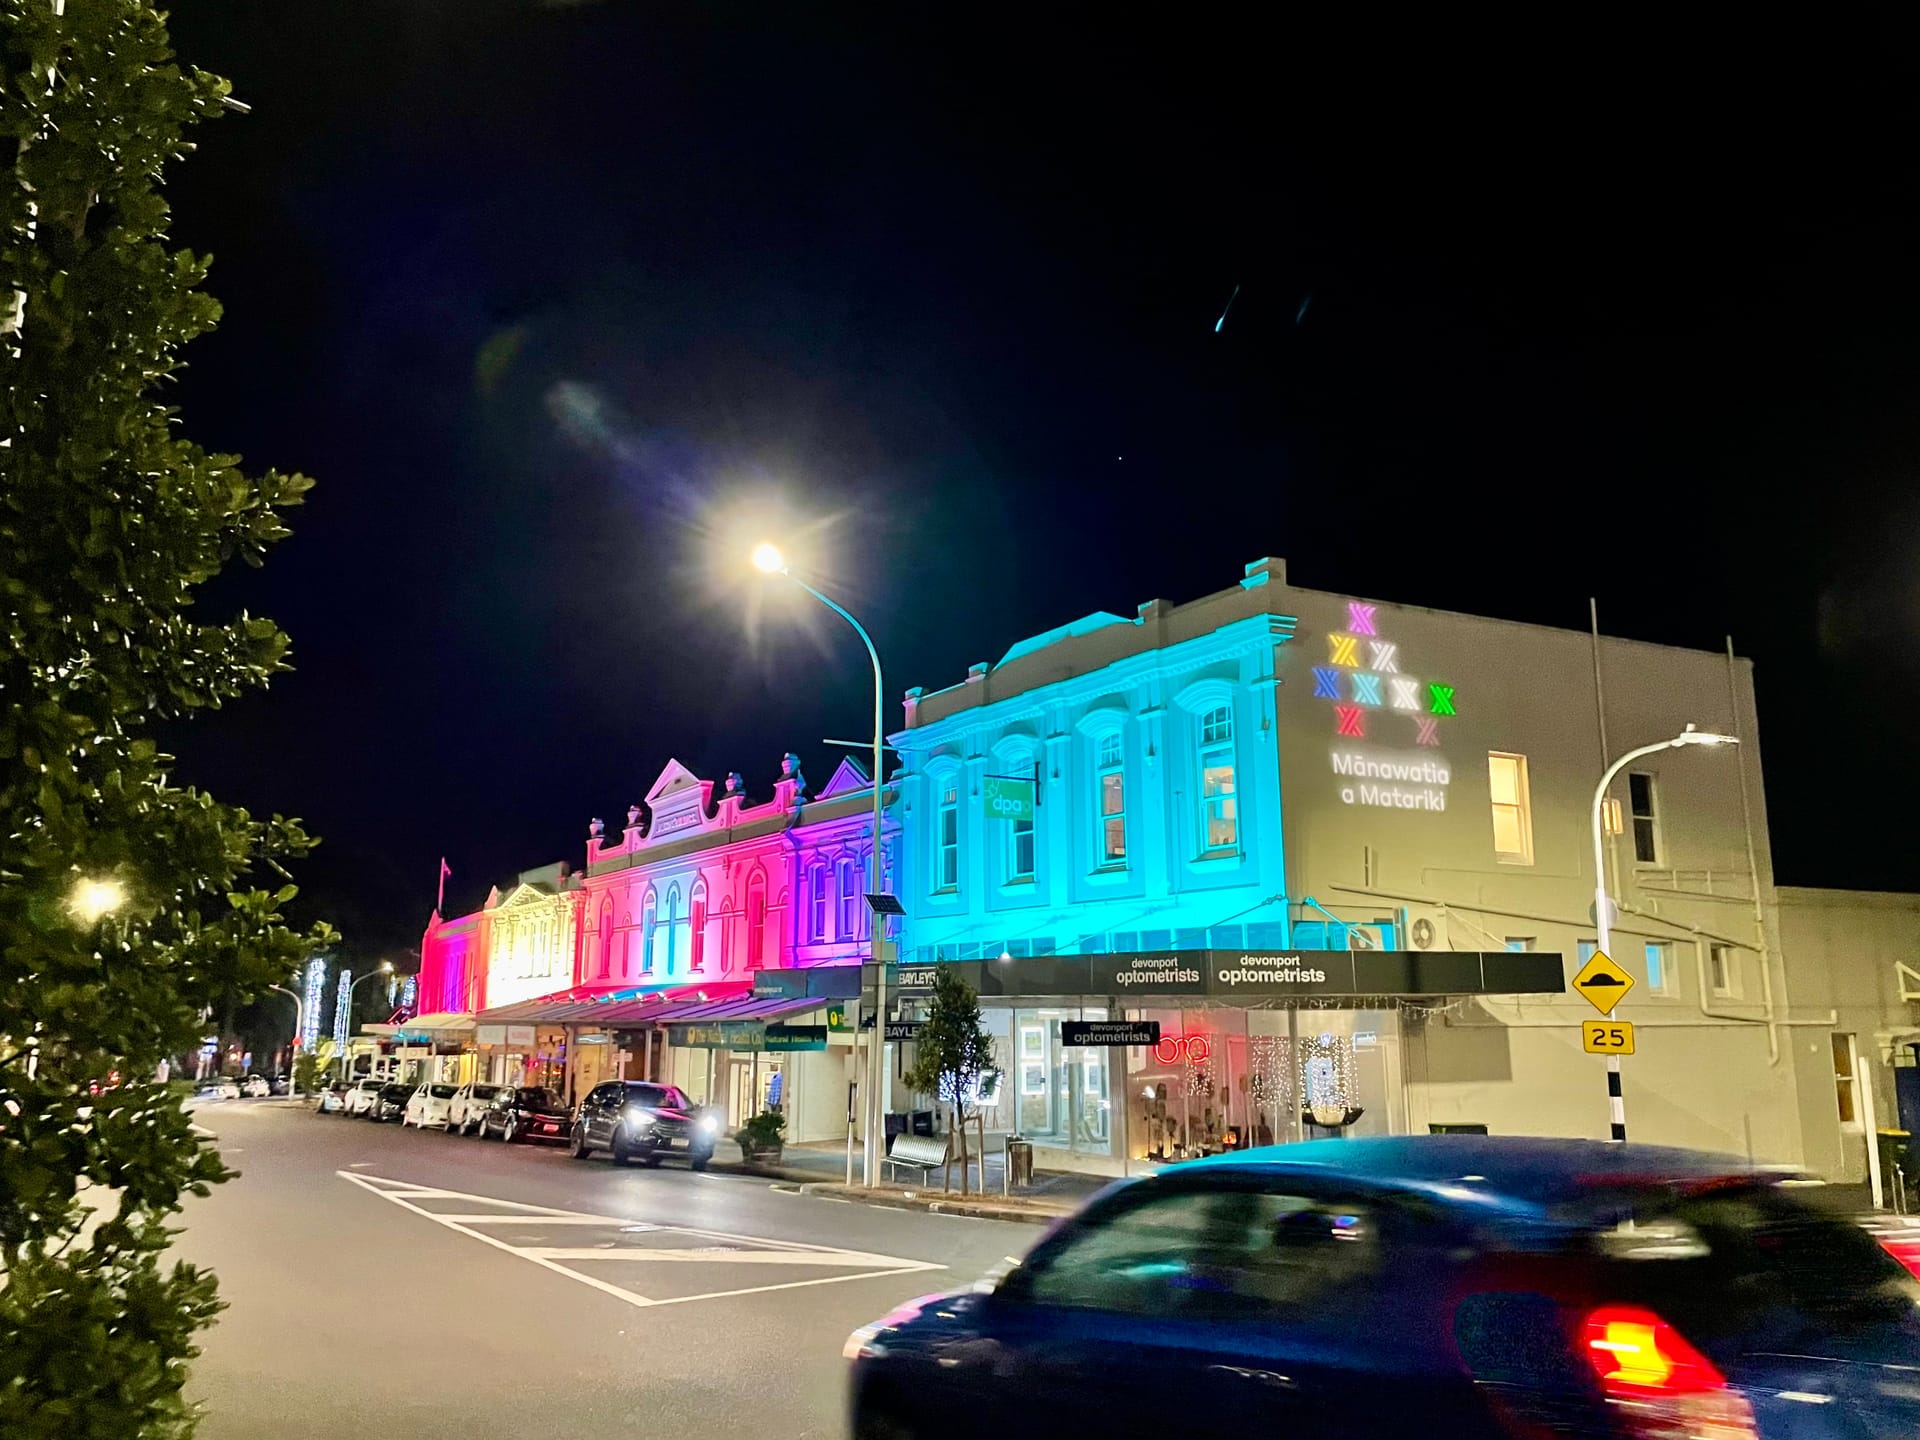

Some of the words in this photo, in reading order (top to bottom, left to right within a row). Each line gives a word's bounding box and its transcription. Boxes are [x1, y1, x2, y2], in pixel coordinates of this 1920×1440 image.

[1332, 753, 1449, 785] Mānawatia
[1342, 788, 1354, 804] a
[1360, 784, 1445, 811] Matariki
[1131, 957, 1178, 970] devonport
[1240, 955, 1300, 968] devonport
[898, 971, 937, 985] BAYLEYS
[1116, 967, 1200, 986] optometrists
[1218, 968, 1326, 986] optometrists
[885, 1026, 920, 1037] BAYLE
[1090, 1024, 1133, 1032] devonport
[1074, 1032, 1151, 1045] optometrists
[1592, 1028, 1625, 1047] 25
